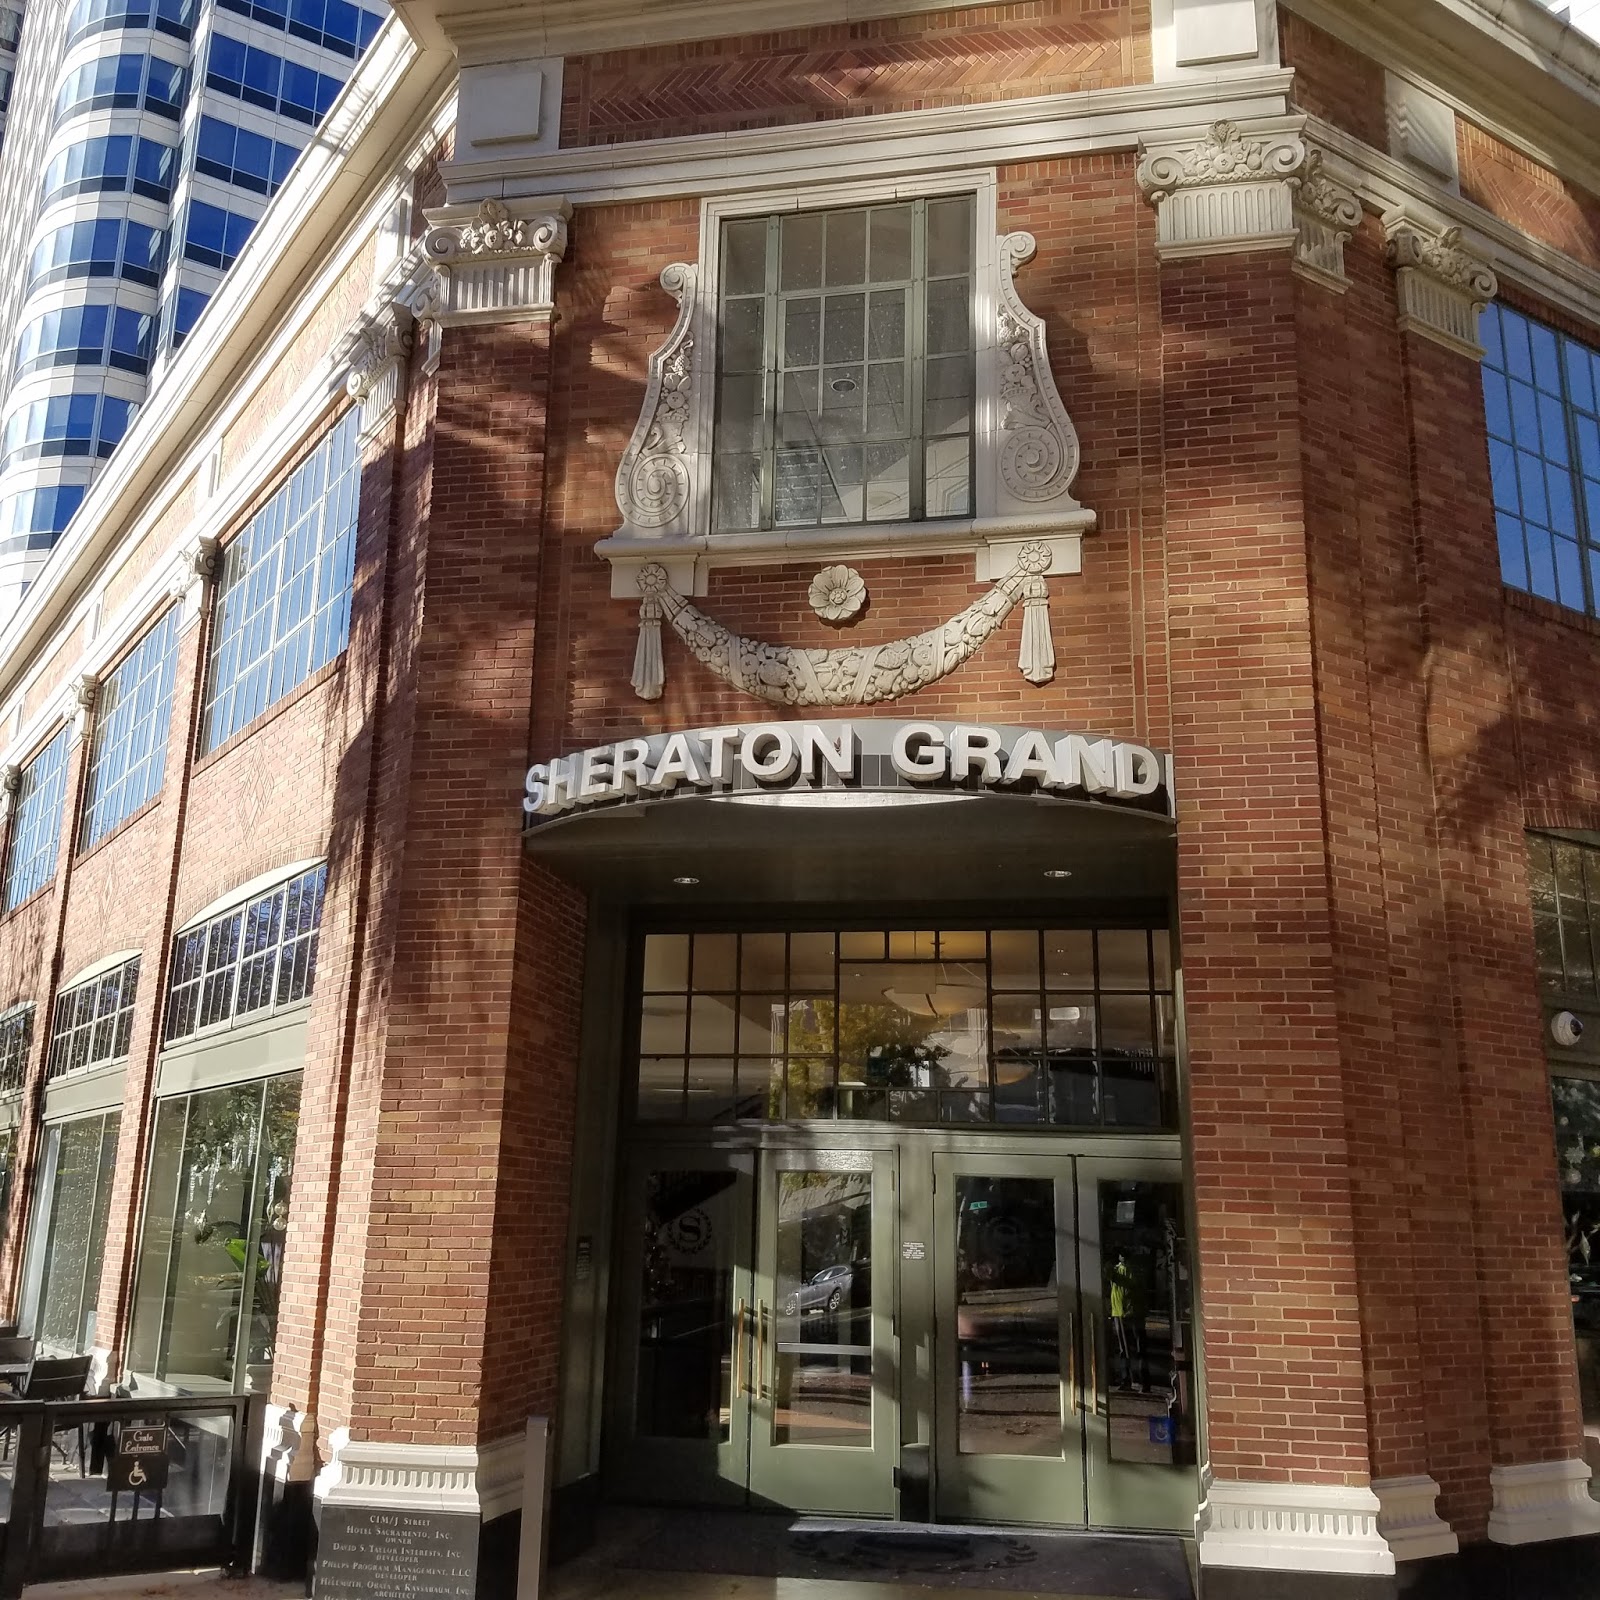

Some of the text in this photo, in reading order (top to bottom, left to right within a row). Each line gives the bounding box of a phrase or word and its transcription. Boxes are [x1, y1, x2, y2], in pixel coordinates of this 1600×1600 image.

[523, 723, 1160, 815] SHERATON GRAND
[125, 1440, 160, 1452] Entrance
[370, 1515, 431, 1527] CIM/J STREET
[346, 1525, 372, 1535] HOTEL
